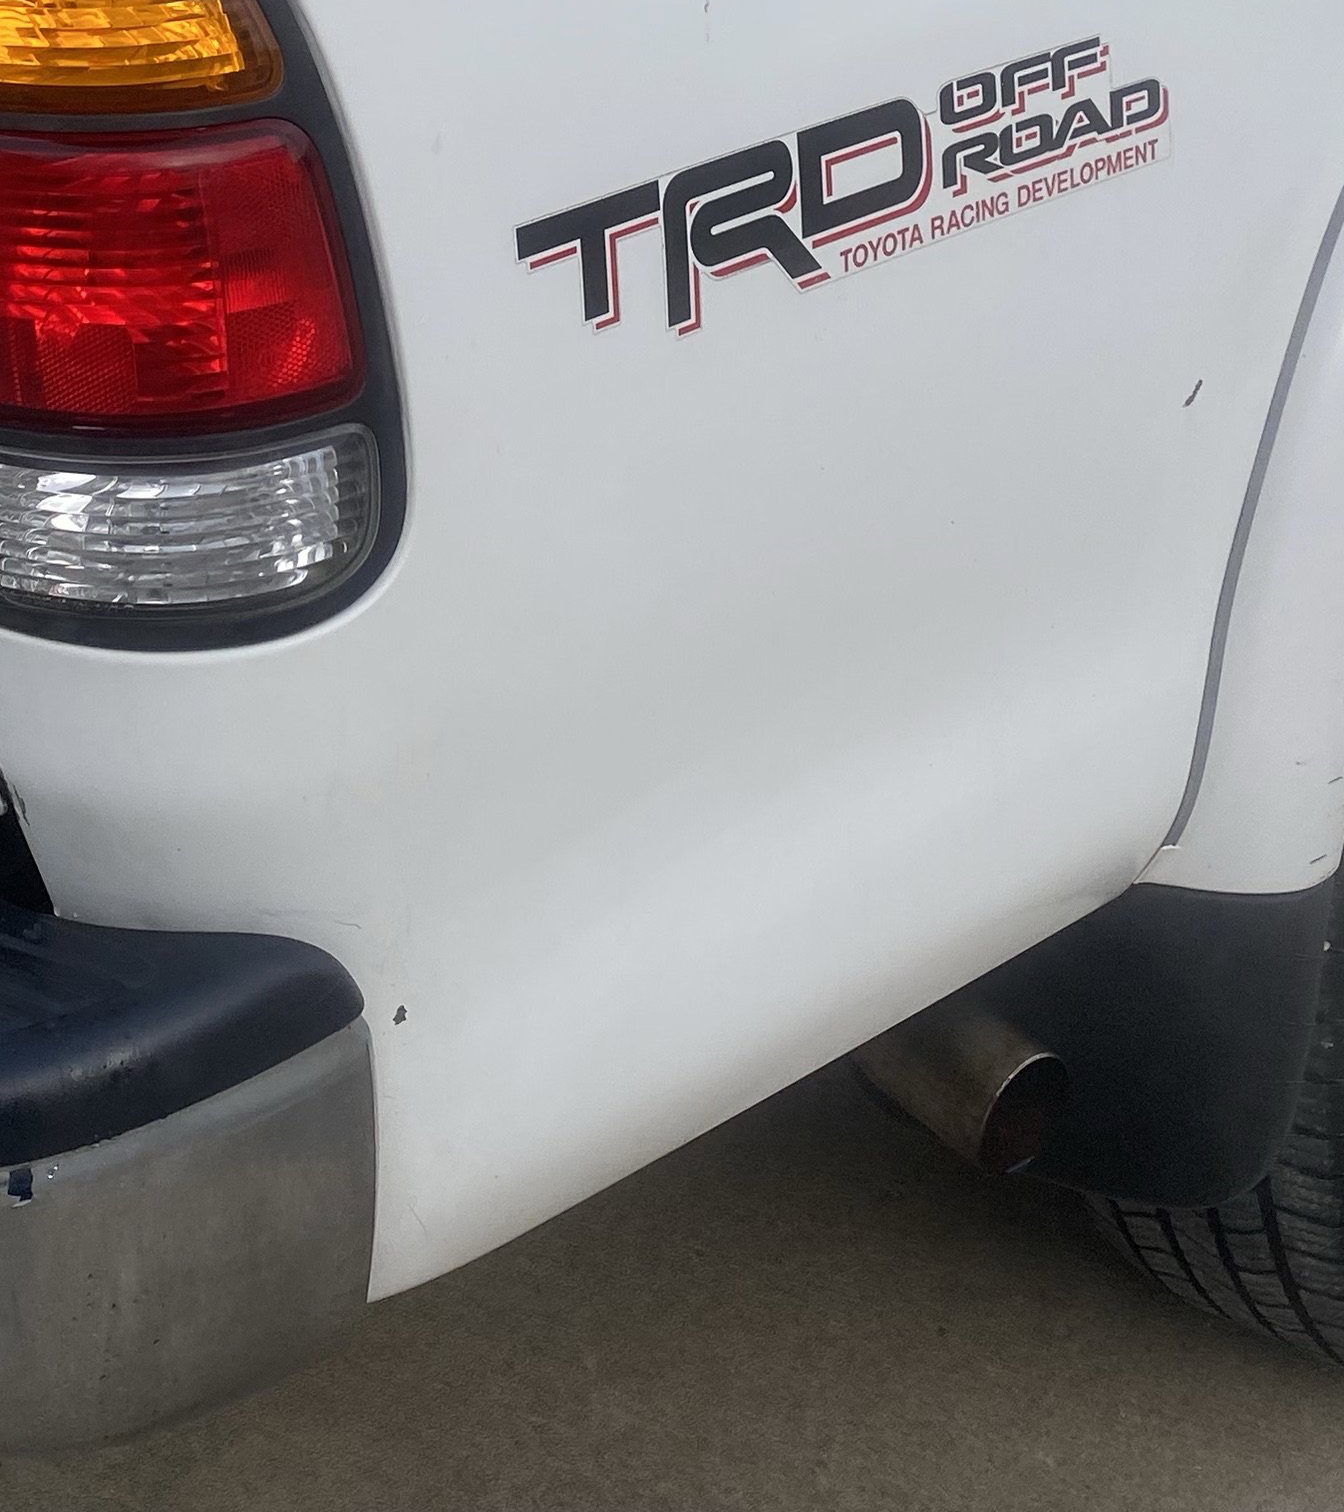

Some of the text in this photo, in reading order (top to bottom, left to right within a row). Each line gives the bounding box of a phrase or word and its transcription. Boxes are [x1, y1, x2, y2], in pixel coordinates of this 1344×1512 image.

[938, 35, 1110, 134] OFF
[942, 78, 1169, 197] ROAD
[515, 98, 933, 337] TRD
[839, 138, 1160, 274] TOYOTA RACING DEVELOPMENT
